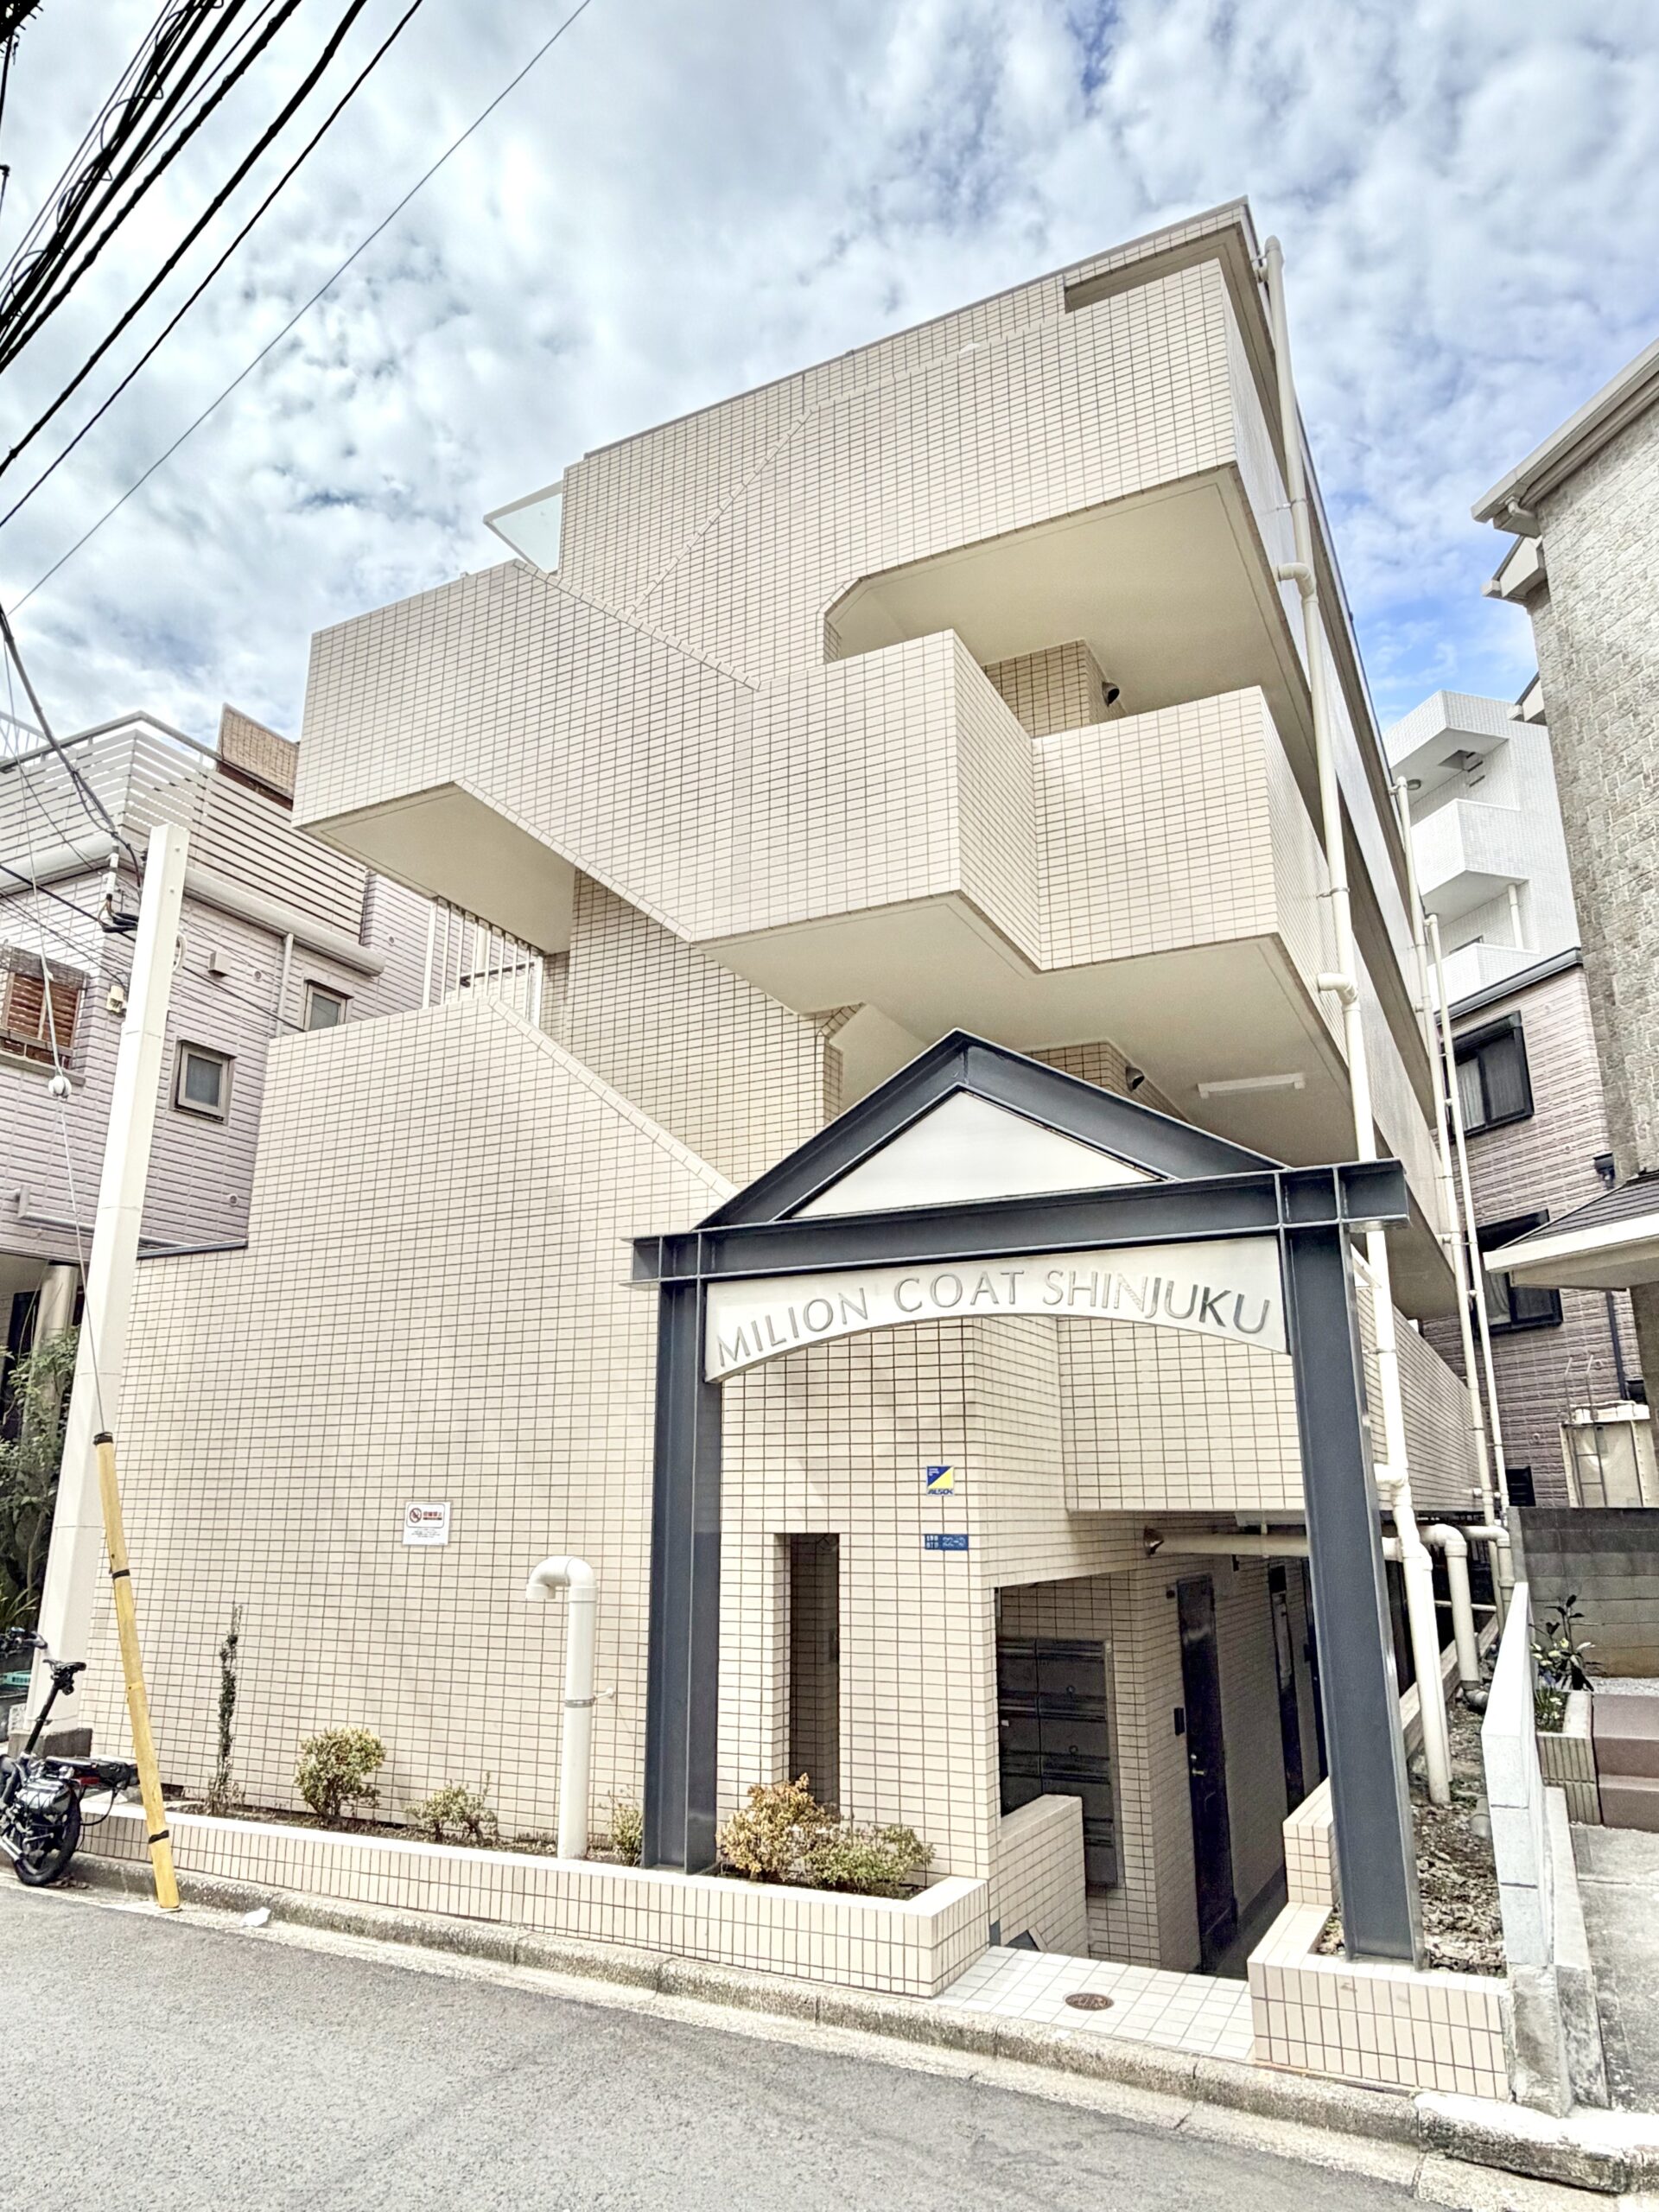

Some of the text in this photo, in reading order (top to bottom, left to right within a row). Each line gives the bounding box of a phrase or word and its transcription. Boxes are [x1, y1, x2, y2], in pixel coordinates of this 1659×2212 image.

[716, 1269, 1270, 1368] MILION COAT SHINJUKU
